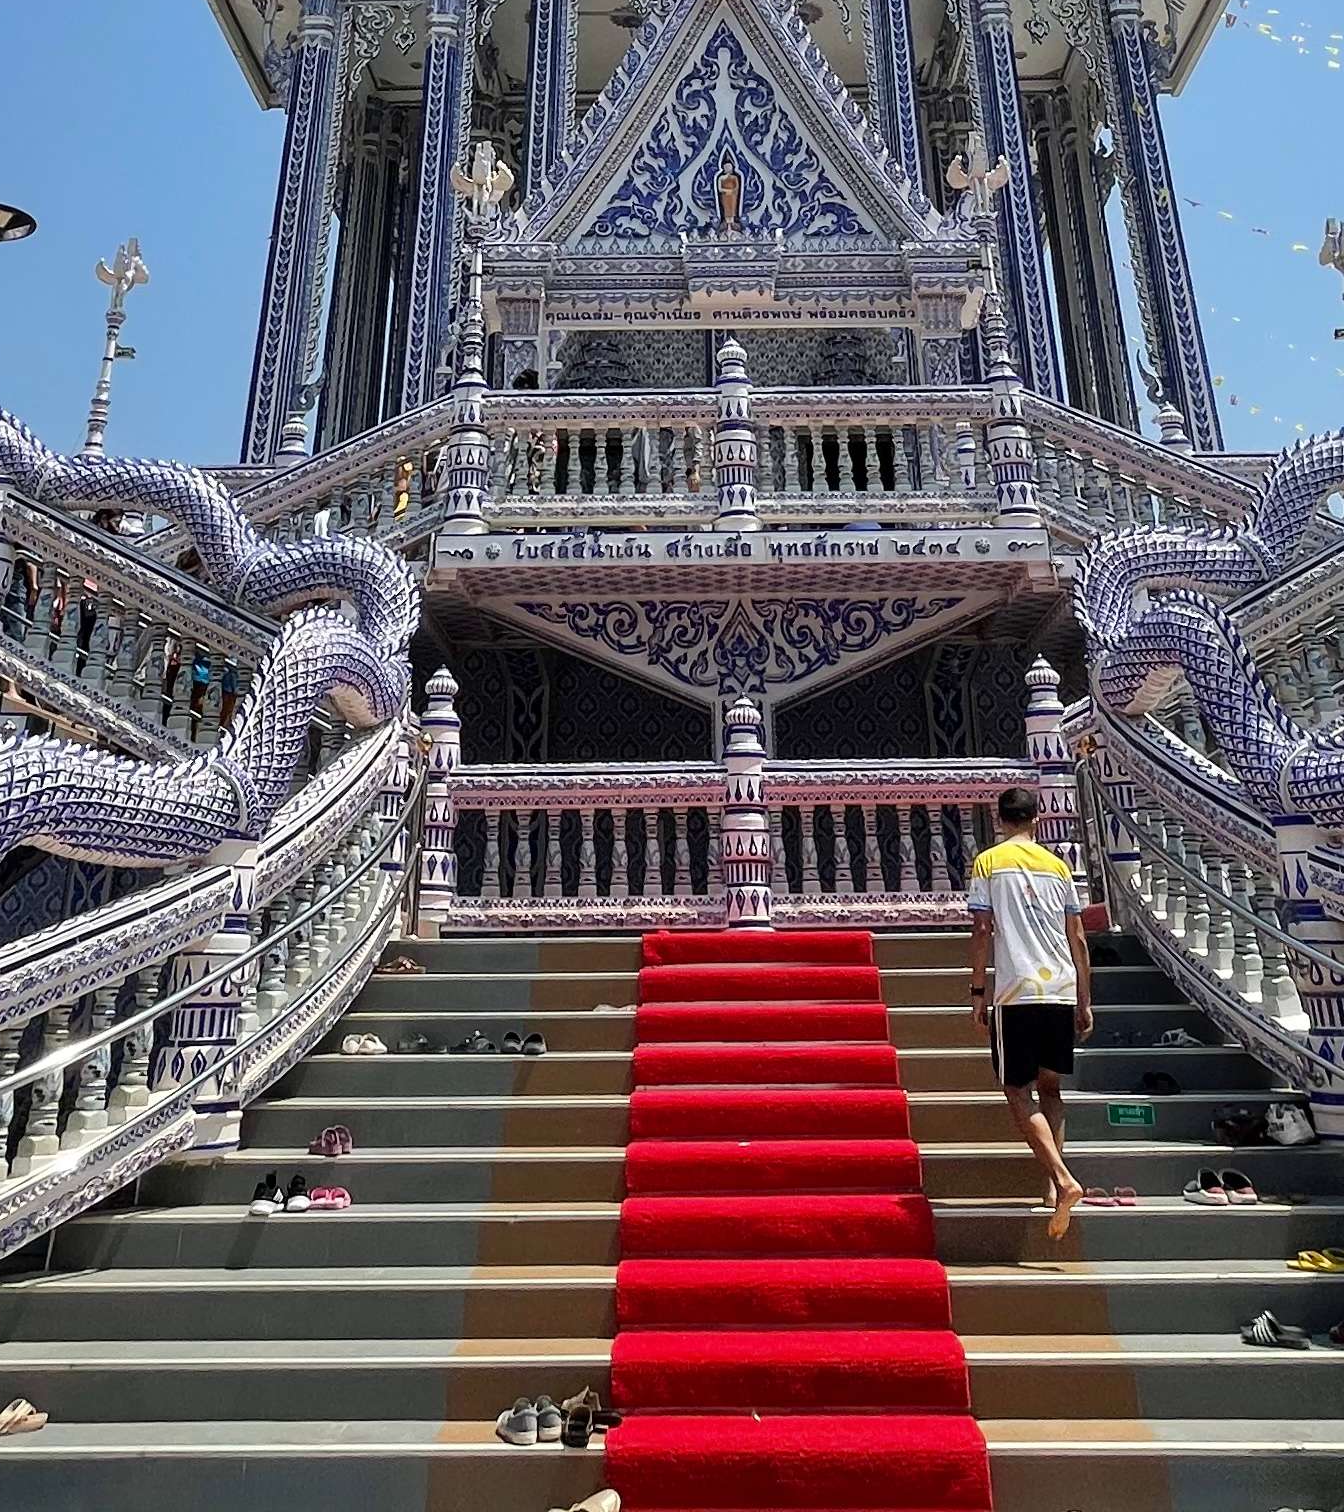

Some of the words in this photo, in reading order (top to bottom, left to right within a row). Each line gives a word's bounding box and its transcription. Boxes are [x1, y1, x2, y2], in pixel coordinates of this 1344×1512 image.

[807, 306, 916, 320] พร้อมครอบครัว
[511, 530, 653, 560] โบสถ์สีน้ำเงิน
[665, 531, 753, 559] สร้างเมื่อ
[767, 532, 880, 564] พุทธศักราช
